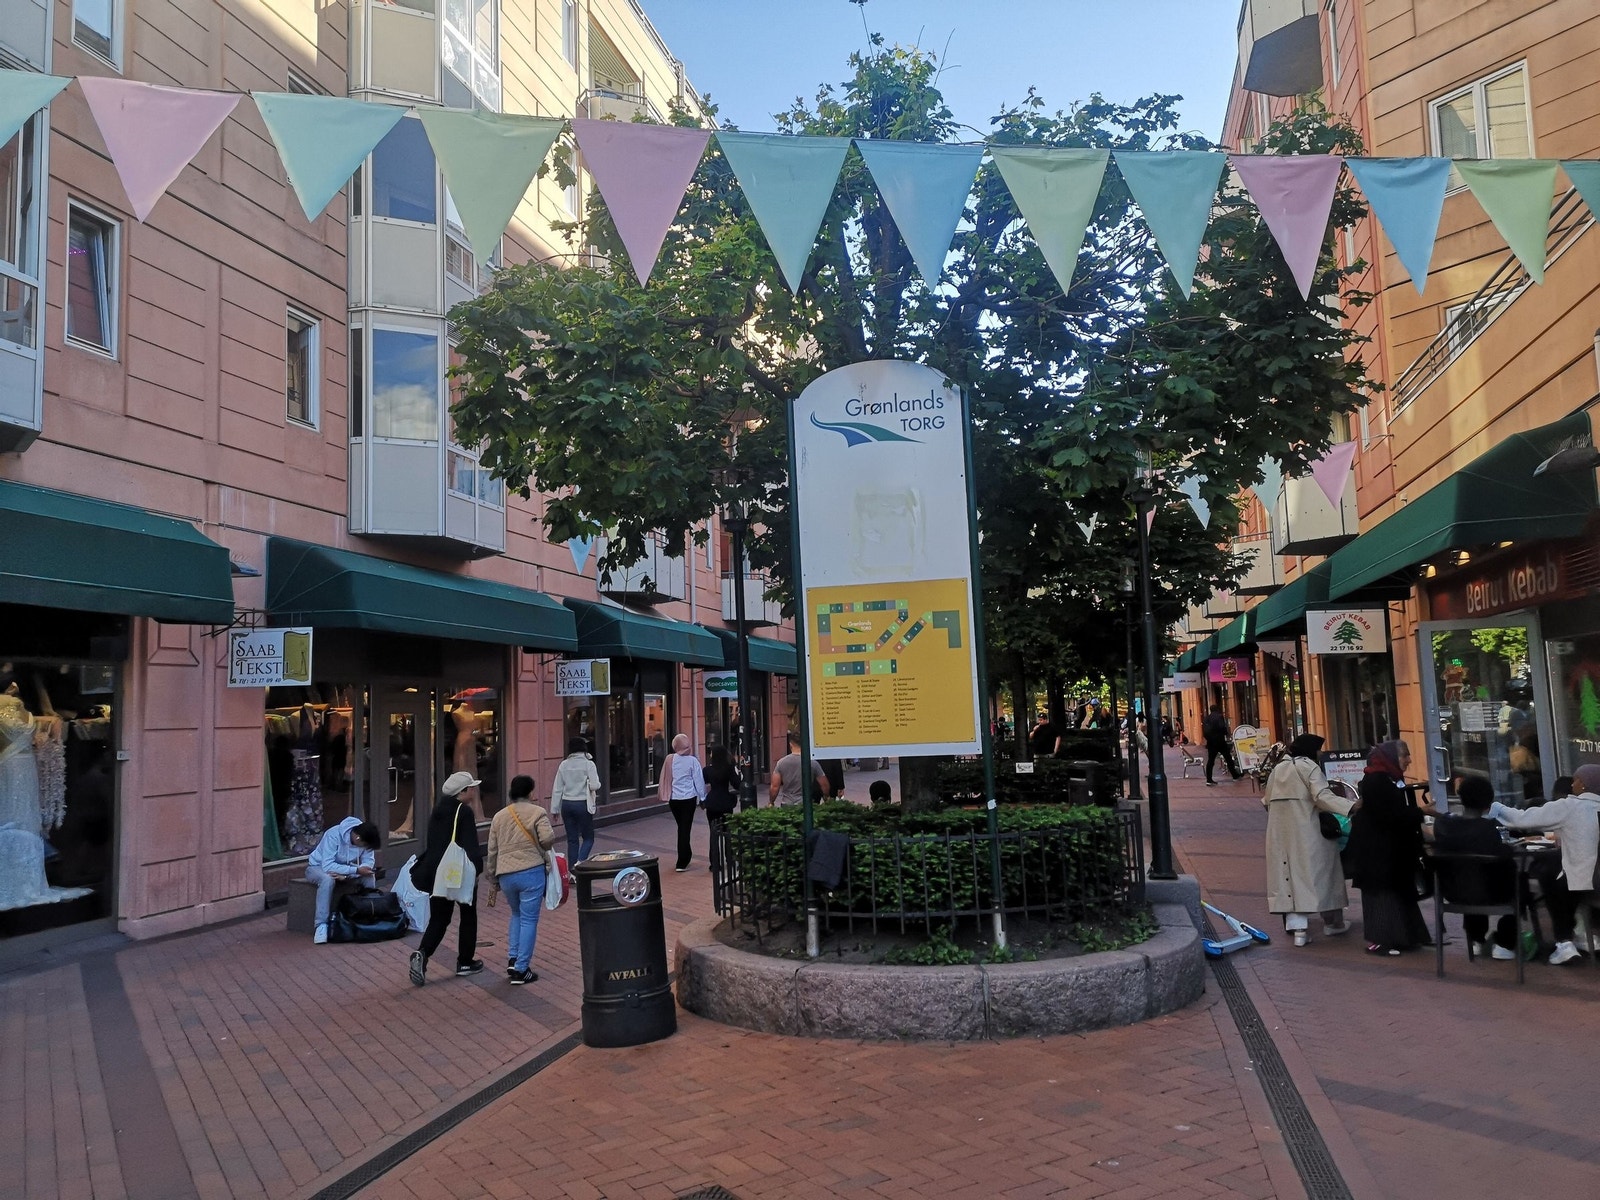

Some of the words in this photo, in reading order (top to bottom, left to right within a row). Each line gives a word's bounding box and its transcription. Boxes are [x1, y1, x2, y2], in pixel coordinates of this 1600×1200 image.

[845, 389, 943, 416] Grønlands
[900, 415, 945, 431] TORG
[1466, 578, 1504, 613] Beirut
[1508, 551, 1558, 602] Kebab
[1323, 613, 1346, 631] BEIRUT
[1348, 613, 1371, 631] KEBAB
